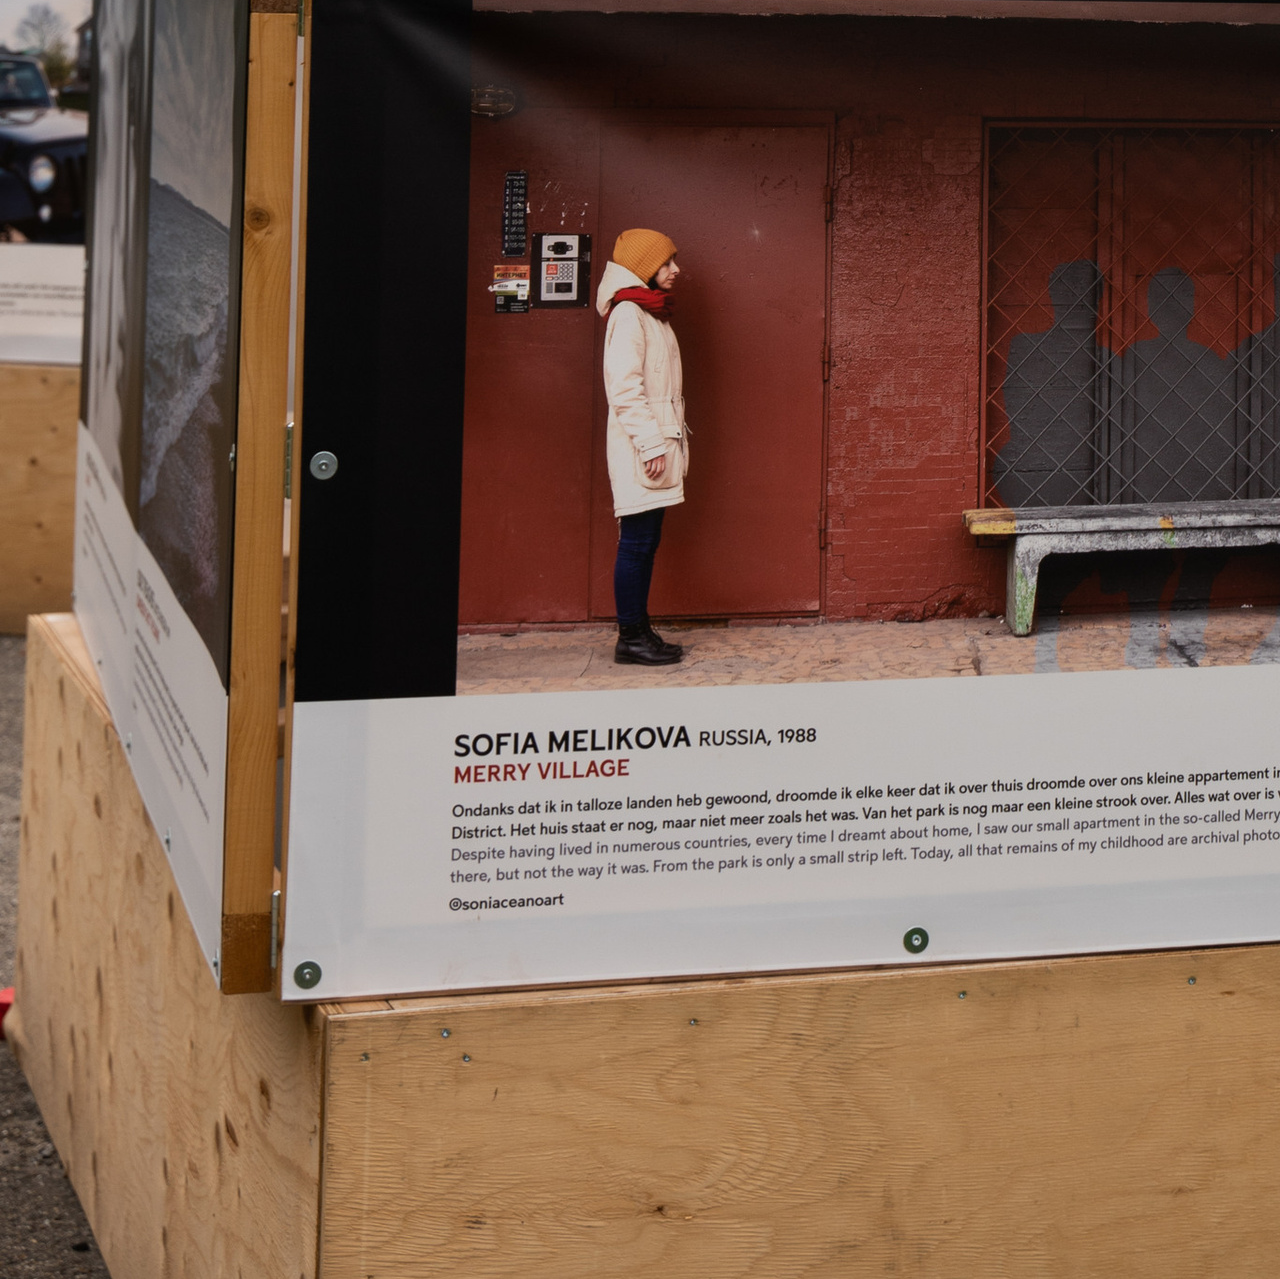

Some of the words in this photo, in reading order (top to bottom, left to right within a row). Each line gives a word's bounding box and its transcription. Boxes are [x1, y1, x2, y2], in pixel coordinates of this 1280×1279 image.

[453, 731, 540, 758] SOFIA
[547, 725, 692, 754] MELIKOVA
[698, 728, 772, 747] RUSSIA,
[777, 727, 817, 744] 1988
[453, 762, 532, 784] MERRY
[537, 758, 630, 780] VILLAGE
[449, 869, 491, 884] there,
[496, 867, 520, 882] but
[523, 866, 548, 880] not
[550, 864, 574, 878] the
[577, 866, 604, 880] way
[607, 862, 617, 875] it
[620, 863, 650, 875] was.
[653, 859, 688, 873] From
[691, 857, 715, 871] the
[718, 855, 749, 874] park
[751, 854, 763, 868] is
[765, 853, 796, 871] only
[798, 855, 806, 866] a
[809, 850, 845, 865] small
[847, 849, 879, 866] strip
[882, 847, 907, 862] left.
[910, 845, 954, 863] Today,
[957, 843, 973, 858] all
[976, 842, 1003, 857] that
[1006, 840, 1058, 855] remains
[1060, 838, 1075, 852] of
[1078, 840, 1098, 854] my
[1100, 833, 1164, 850] childhood
[1167, 835, 1188, 847] are
[1190, 829, 1240, 845] archival
[448, 893, 565, 912] @soniaceanoart
